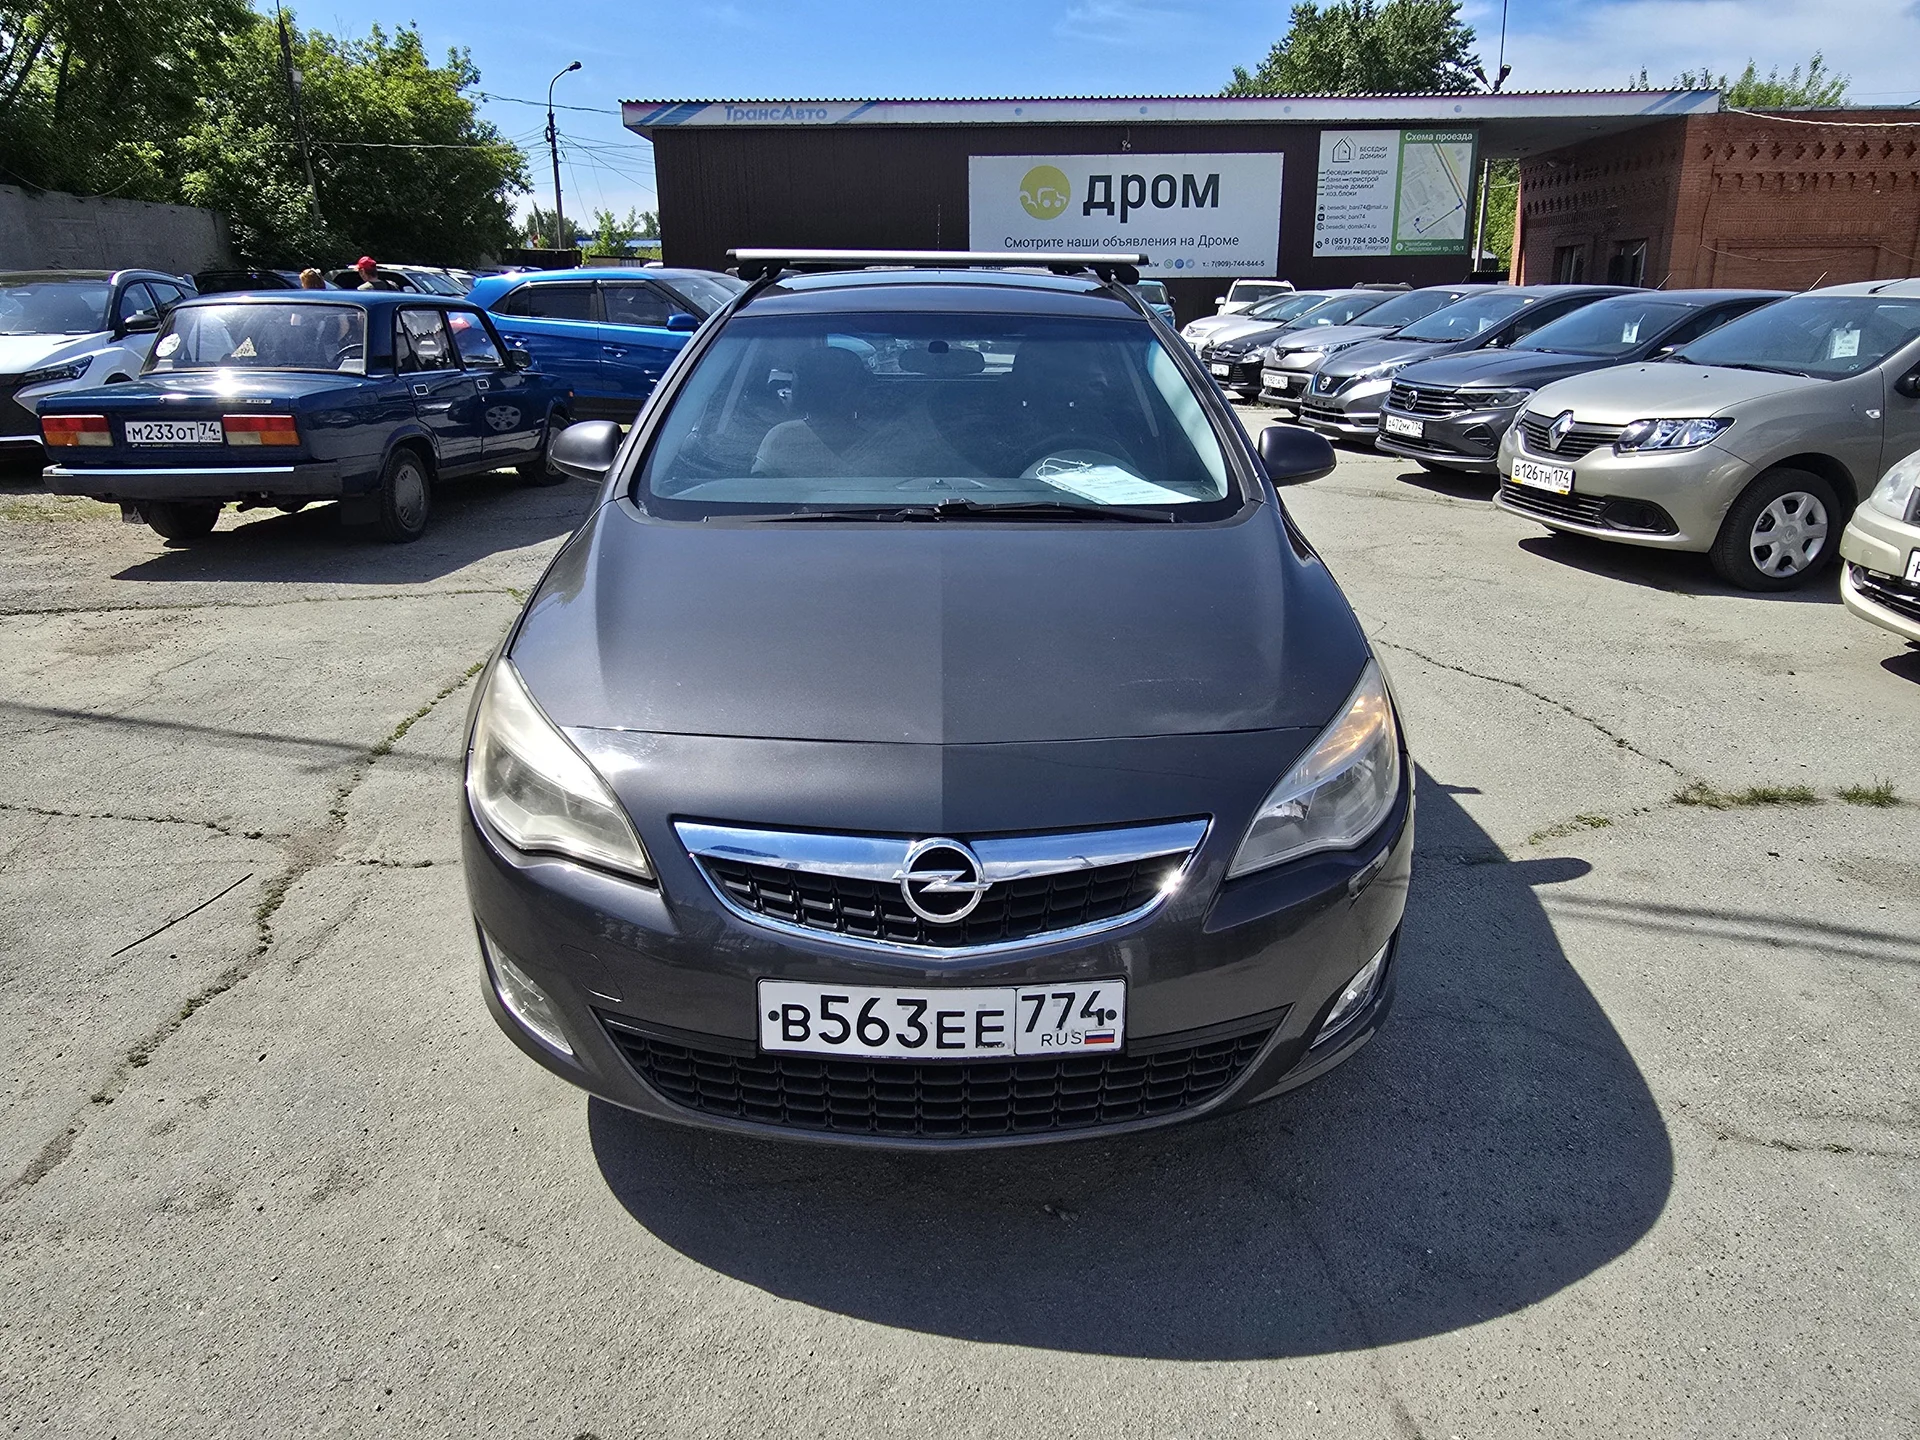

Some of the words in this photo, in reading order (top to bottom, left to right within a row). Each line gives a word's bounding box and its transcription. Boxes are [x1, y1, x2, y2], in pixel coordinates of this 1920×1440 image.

[725, 105, 828, 122] ТрансАвто
[1405, 132, 1434, 141] Схема
[1435, 133, 1473, 142] проезда
[1082, 173, 1220, 224] дром
[1004, 236, 1064, 250] Смотрите
[1067, 237, 1099, 247] наши
[1102, 235, 1176, 247] объявления
[1180, 237, 1194, 246] на
[1197, 235, 1239, 249] Дроме
[1324, 237, 1330, 245] 8
[1331, 237, 1351, 246] (951)
[1352, 237, 1366, 245] 784
[1368, 236, 1390, 244] 30-50
[1211, 260, 1265, 268] 7(909)-744-844-5
[131, 424, 196, 441] М233ОТ
[199, 422, 216, 436] 74
[1514, 463, 1552, 484] В126ТН
[1553, 469, 1570, 484] 174
[782, 994, 1005, 1049] В563ЕЕ
[1021, 990, 1105, 1034] 774
[1041, 1031, 1083, 1047] RUS
